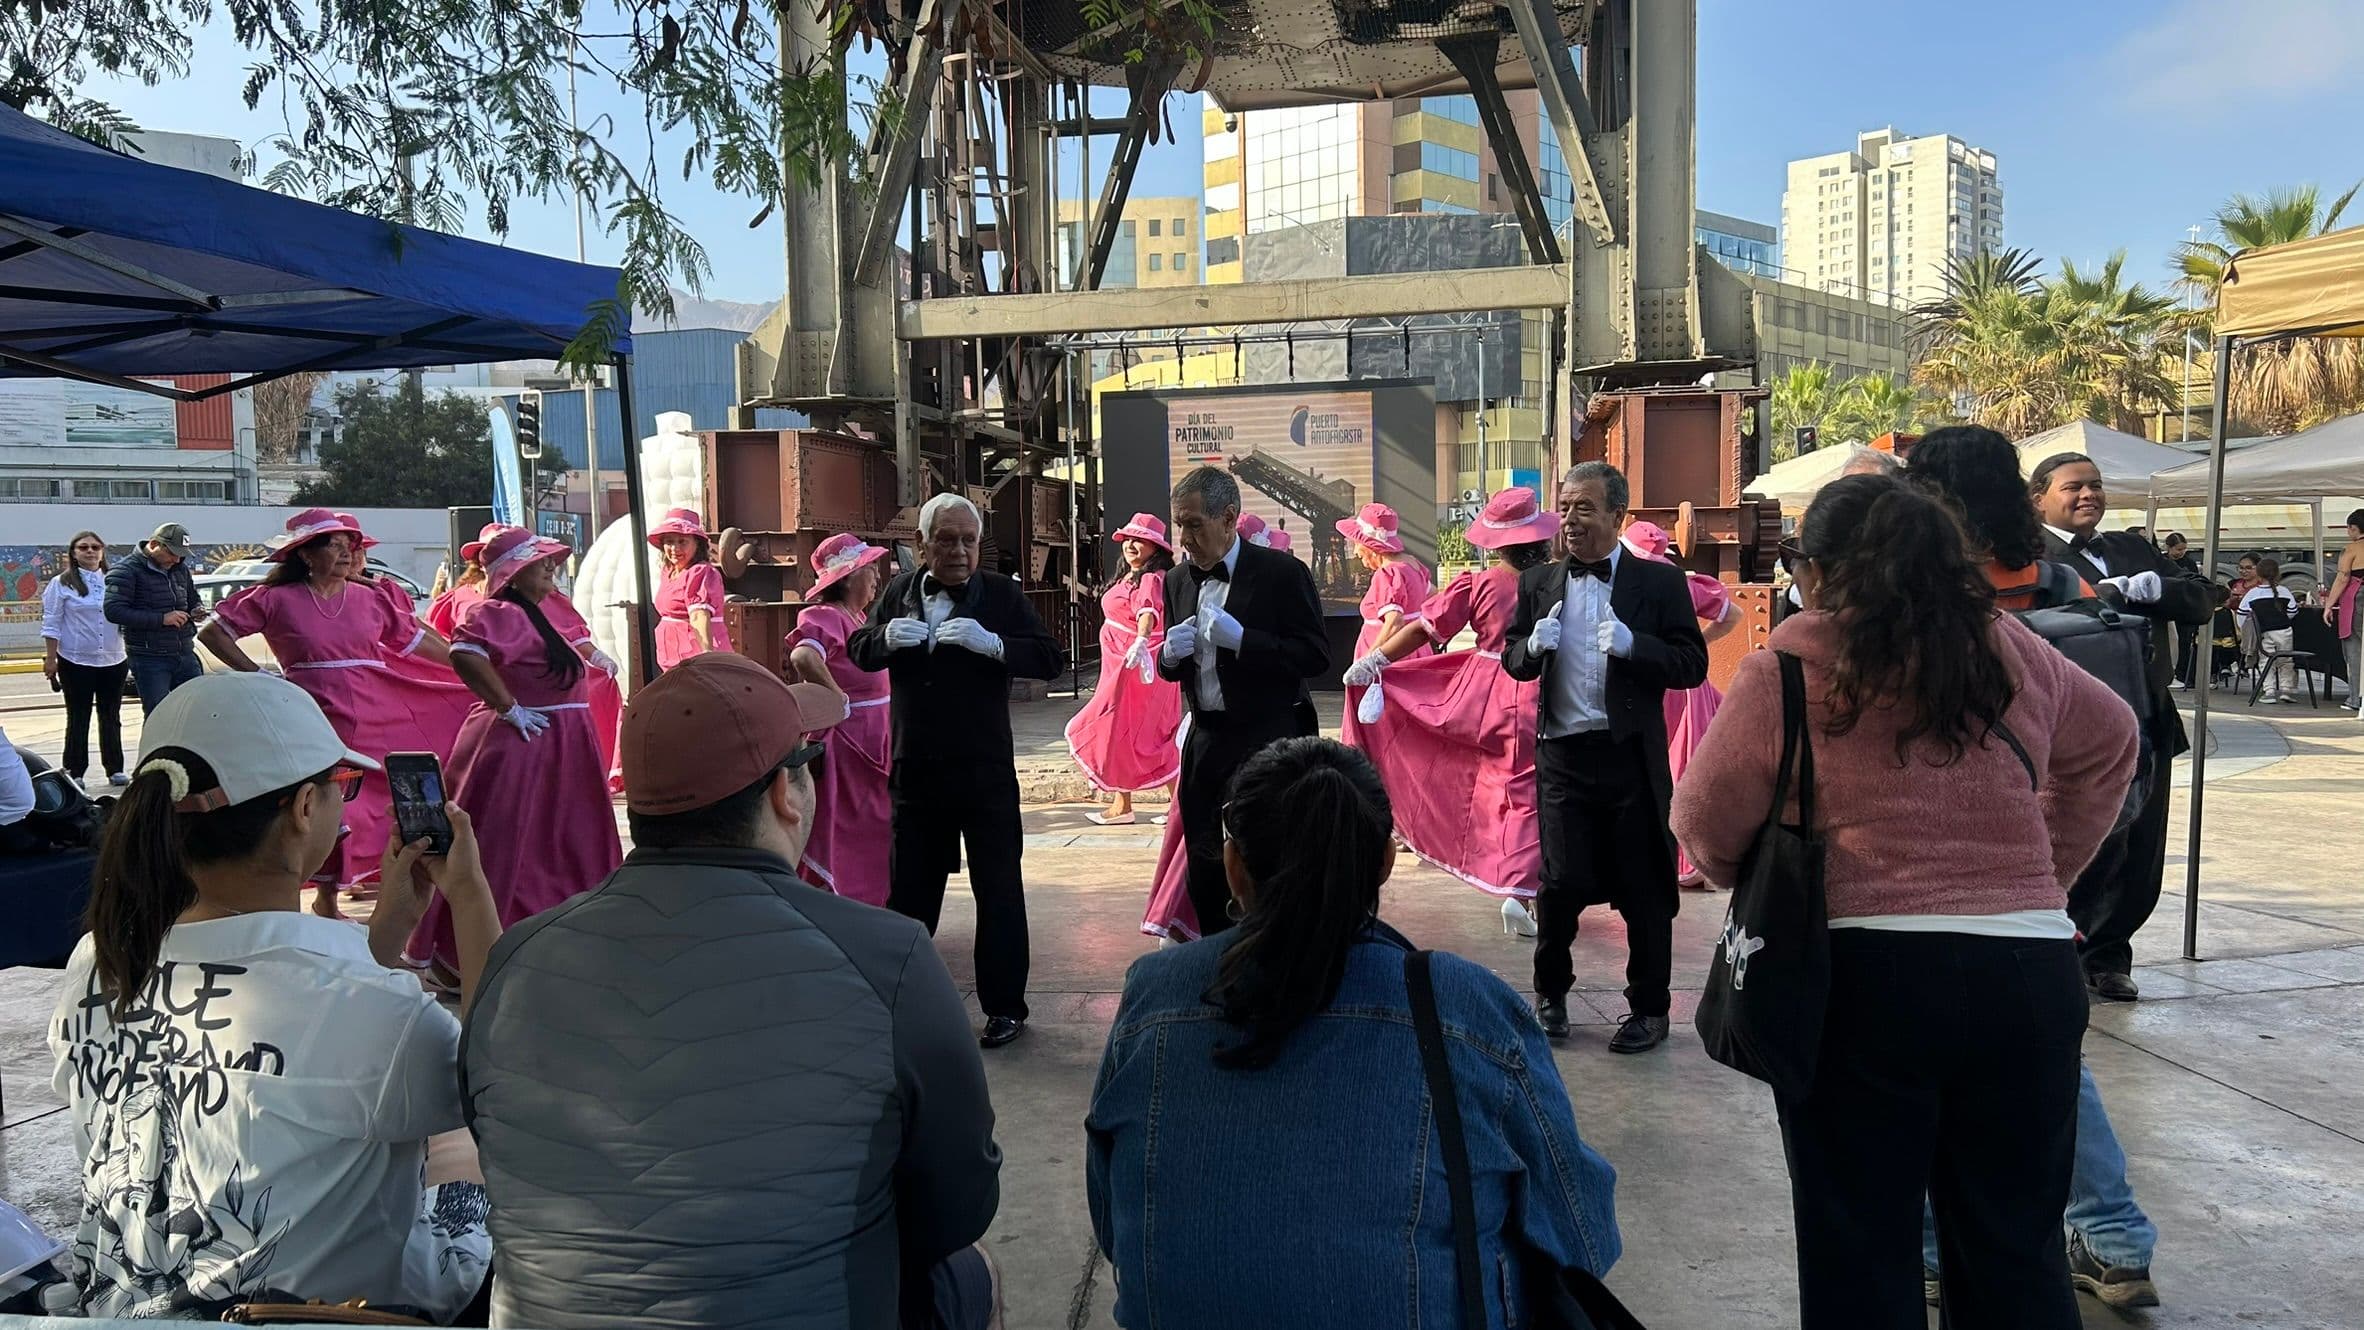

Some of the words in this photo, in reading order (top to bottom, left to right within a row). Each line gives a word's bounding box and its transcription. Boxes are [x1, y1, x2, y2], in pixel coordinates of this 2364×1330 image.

[1188, 411, 1200, 425] DÍA
[1203, 412, 1217, 425] DEL
[1311, 413, 1339, 428] PUERTO
[1175, 425, 1234, 442] PATRIMONIO
[1311, 428, 1363, 445] ANTOFAGASTA
[1186, 441, 1223, 454] CULTURAL
